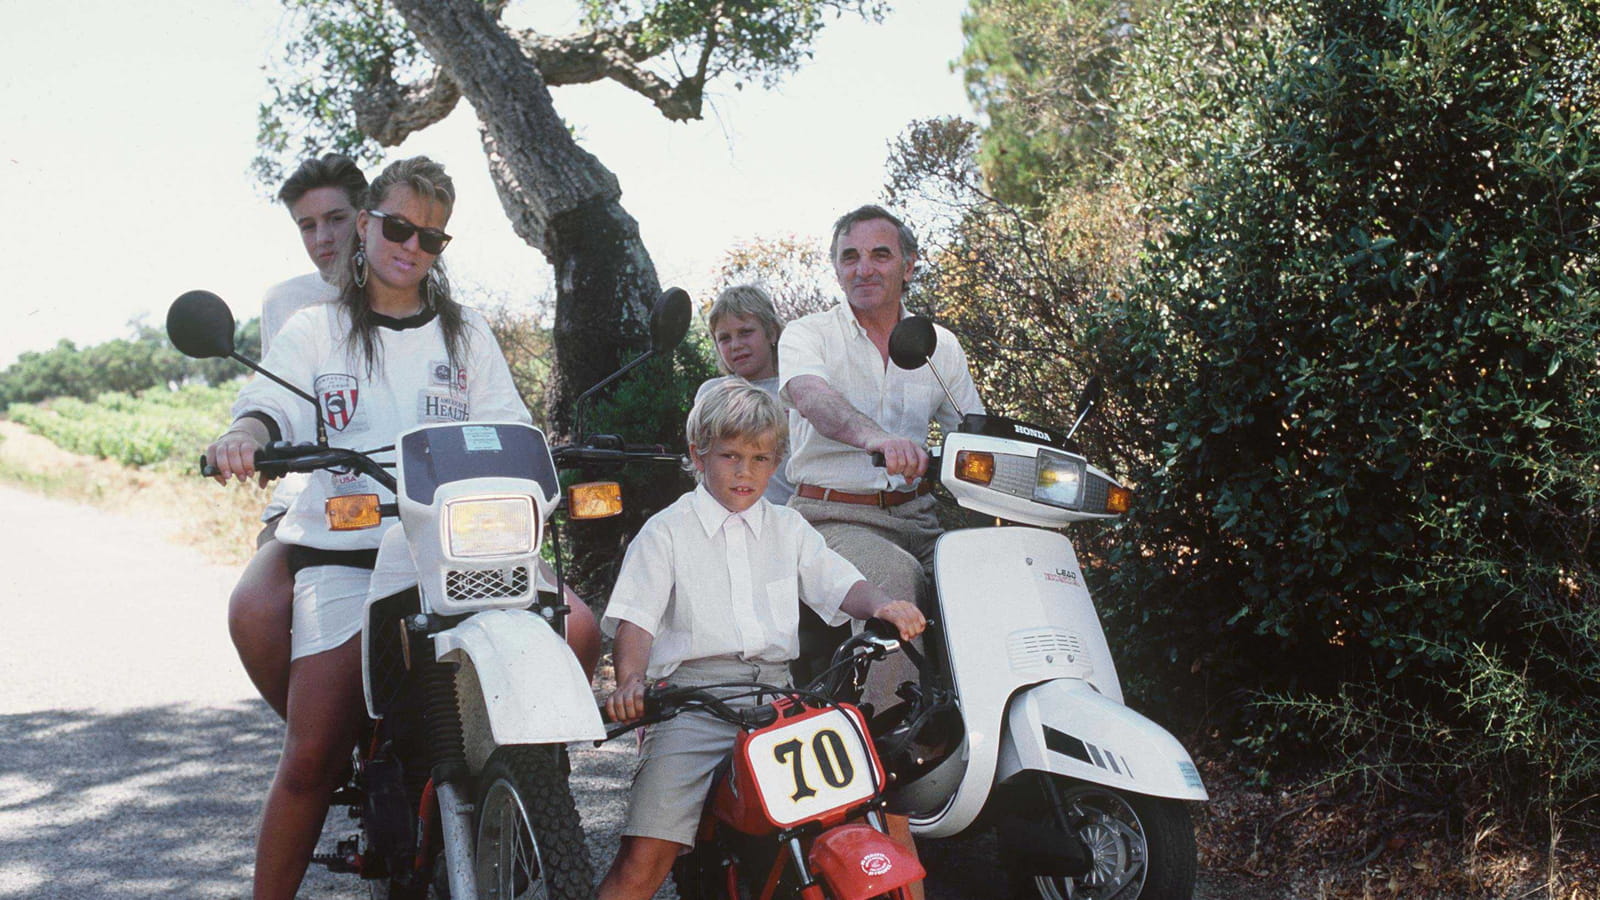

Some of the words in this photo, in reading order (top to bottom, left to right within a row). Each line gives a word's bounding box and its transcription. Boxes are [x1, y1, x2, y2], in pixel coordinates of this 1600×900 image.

[426, 396, 470, 421] HEALTH
[1014, 424, 1052, 442] HONDA
[340, 475, 357, 484] USA
[1055, 568, 1077, 579] LEAD
[773, 729, 855, 802] 70
